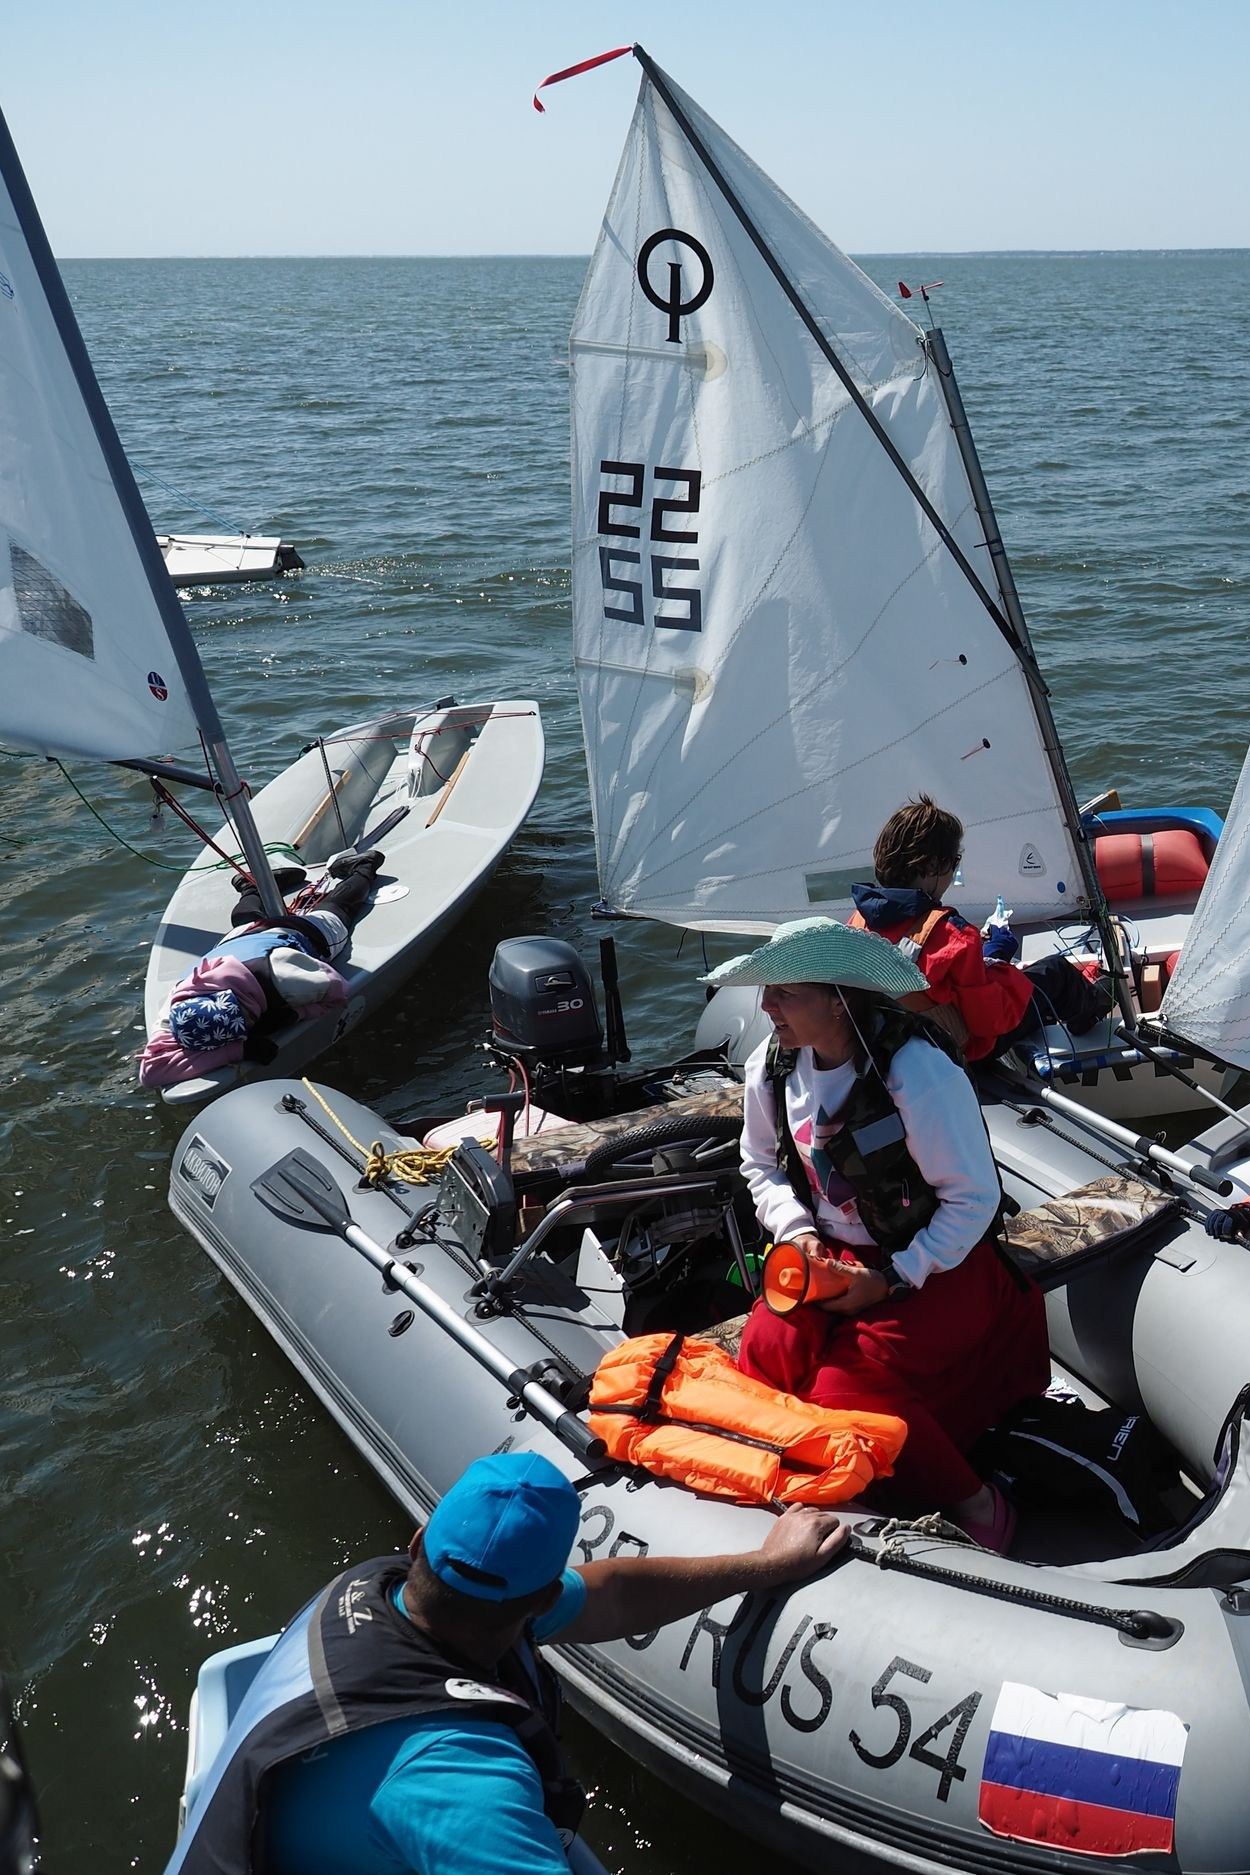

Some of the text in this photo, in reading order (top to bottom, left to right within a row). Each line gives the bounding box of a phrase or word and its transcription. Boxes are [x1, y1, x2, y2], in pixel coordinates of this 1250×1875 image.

[598, 460, 702, 544] 22
[557, 998, 584, 1013] 30
[183, 1148, 222, 1196] АКВИЛОН
[679, 1591, 984, 1804] RUS 54
